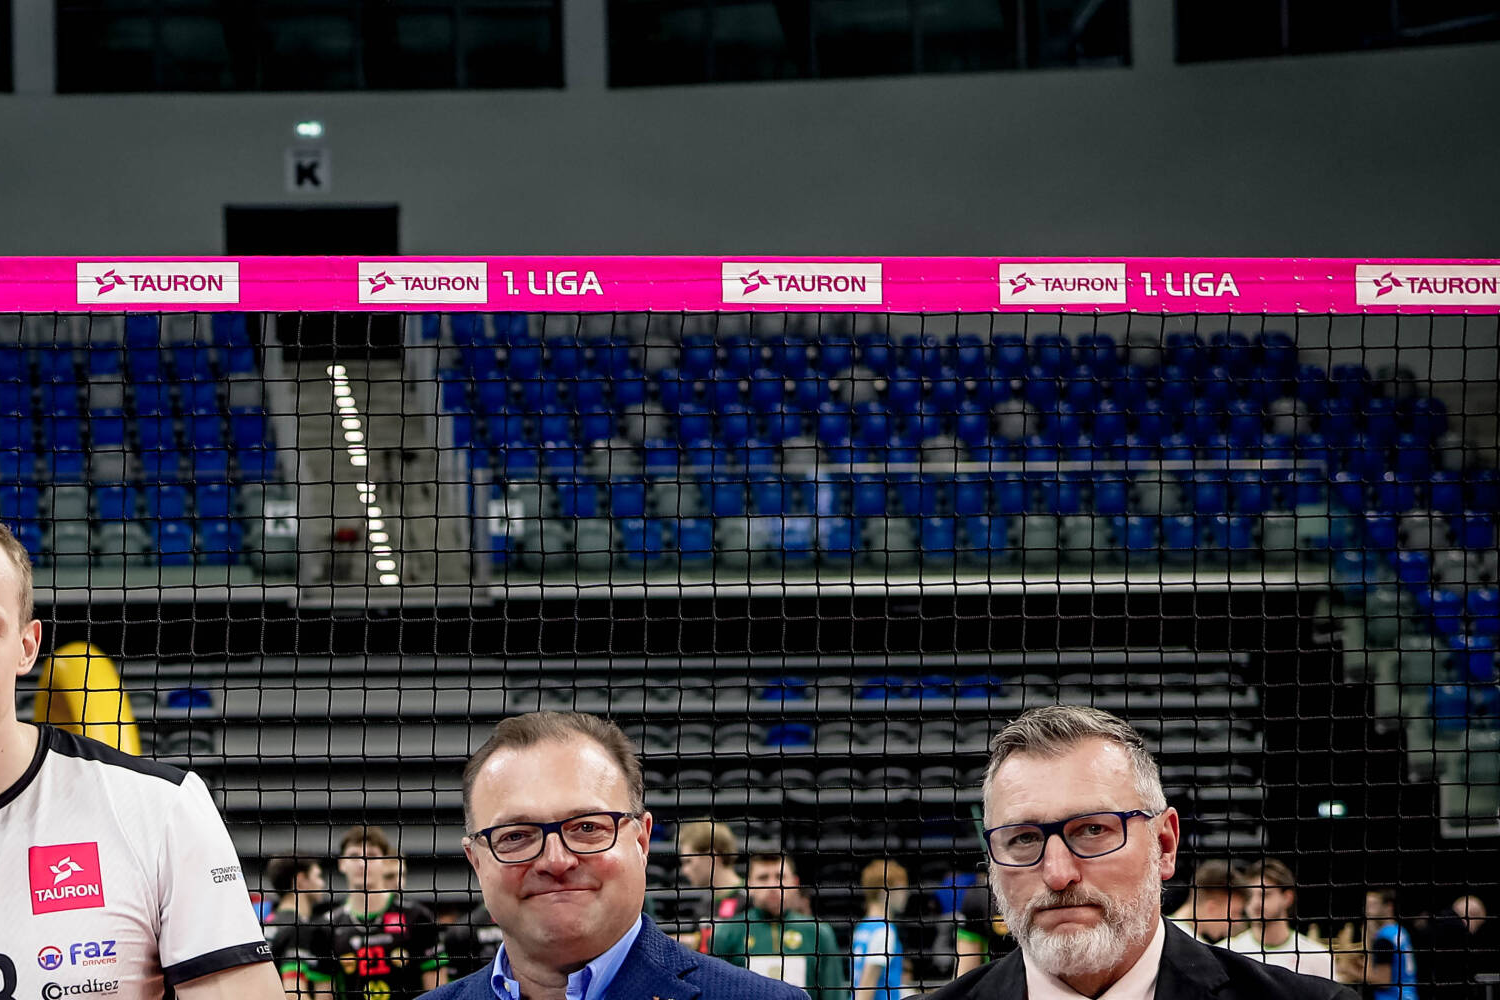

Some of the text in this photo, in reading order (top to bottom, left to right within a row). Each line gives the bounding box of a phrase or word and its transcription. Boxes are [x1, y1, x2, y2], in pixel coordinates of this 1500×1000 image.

[295, 161, 321, 187] K
[129, 274, 223, 292] TAURON
[401, 276, 480, 292] TAURON
[502, 271, 604, 295] 1. LIGA
[773, 275, 866, 292] TAURON
[1041, 277, 1118, 292] TAURON
[1139, 272, 1239, 297] 1. LIGA
[1406, 276, 1498, 295] TAURON
[35, 884, 100, 902] TAURON
[82, 957, 117, 967] DRIVERS
